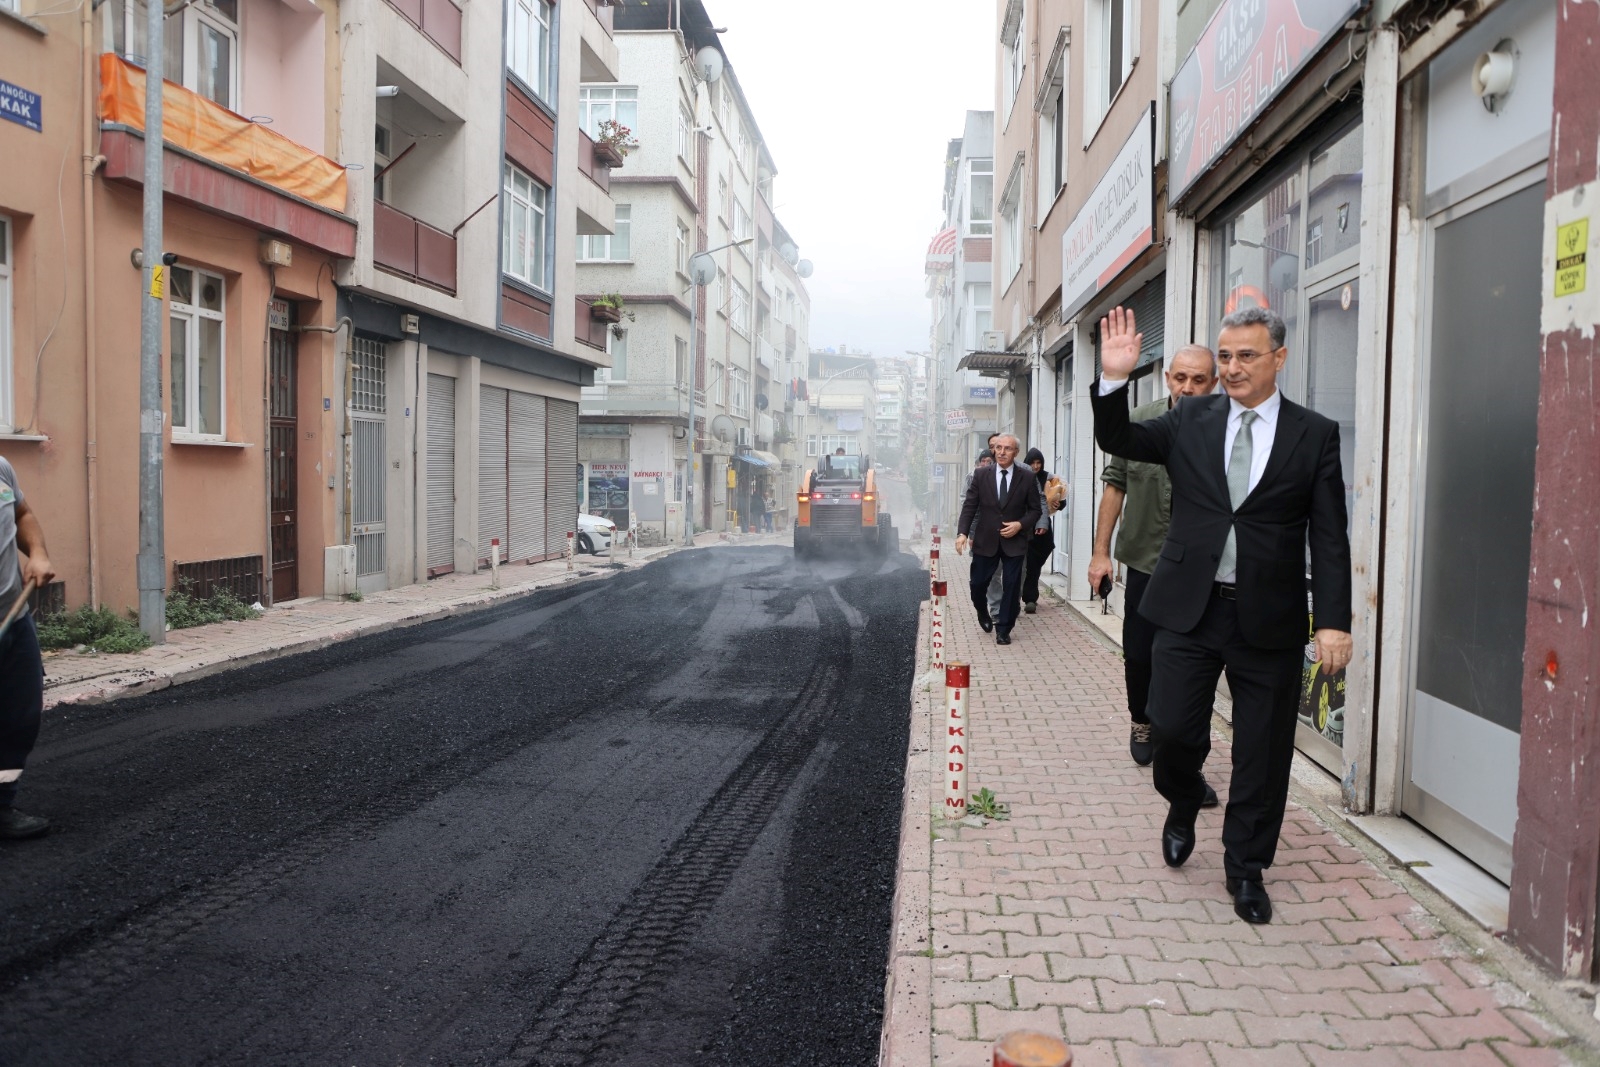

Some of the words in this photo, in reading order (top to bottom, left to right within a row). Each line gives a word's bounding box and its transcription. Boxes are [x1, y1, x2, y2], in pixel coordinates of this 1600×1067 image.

[1224, 27, 1252, 78] reklam
[1200, 24, 1289, 168] TABELA
[1564, 281, 1576, 291] VAR
[946, 688, 964, 808] İLKADIM
